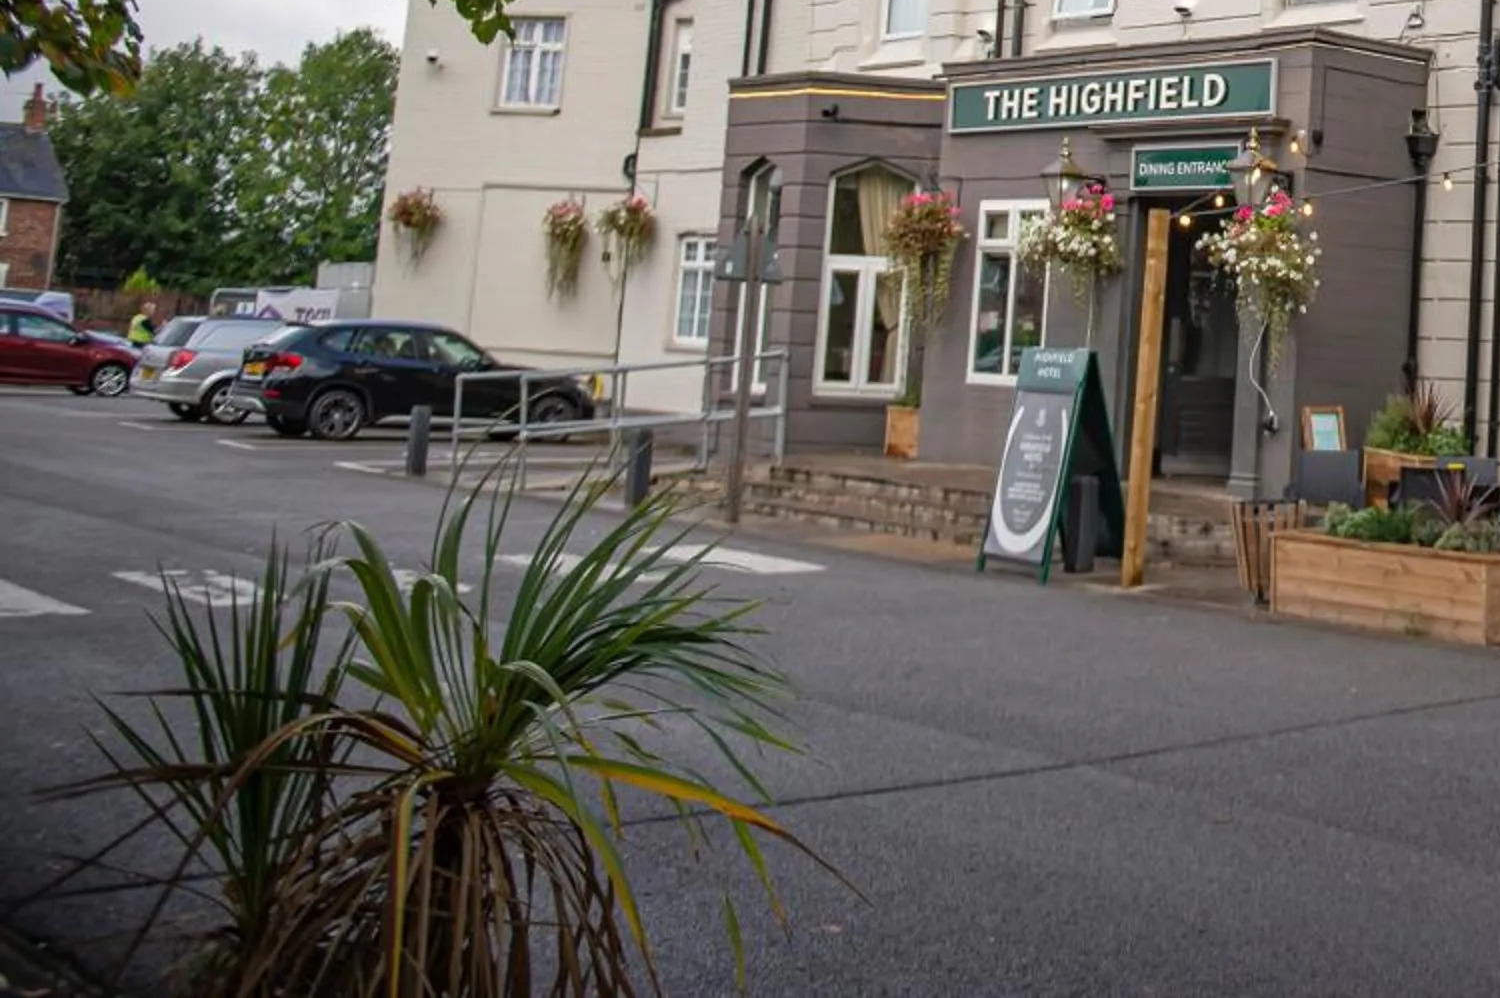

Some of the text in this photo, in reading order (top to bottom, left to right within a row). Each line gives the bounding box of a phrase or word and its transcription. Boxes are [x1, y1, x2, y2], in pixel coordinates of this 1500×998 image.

[983, 73, 1228, 121] THE HIGHFIELD
[1138, 159, 1230, 176] DINING ENTRANC
